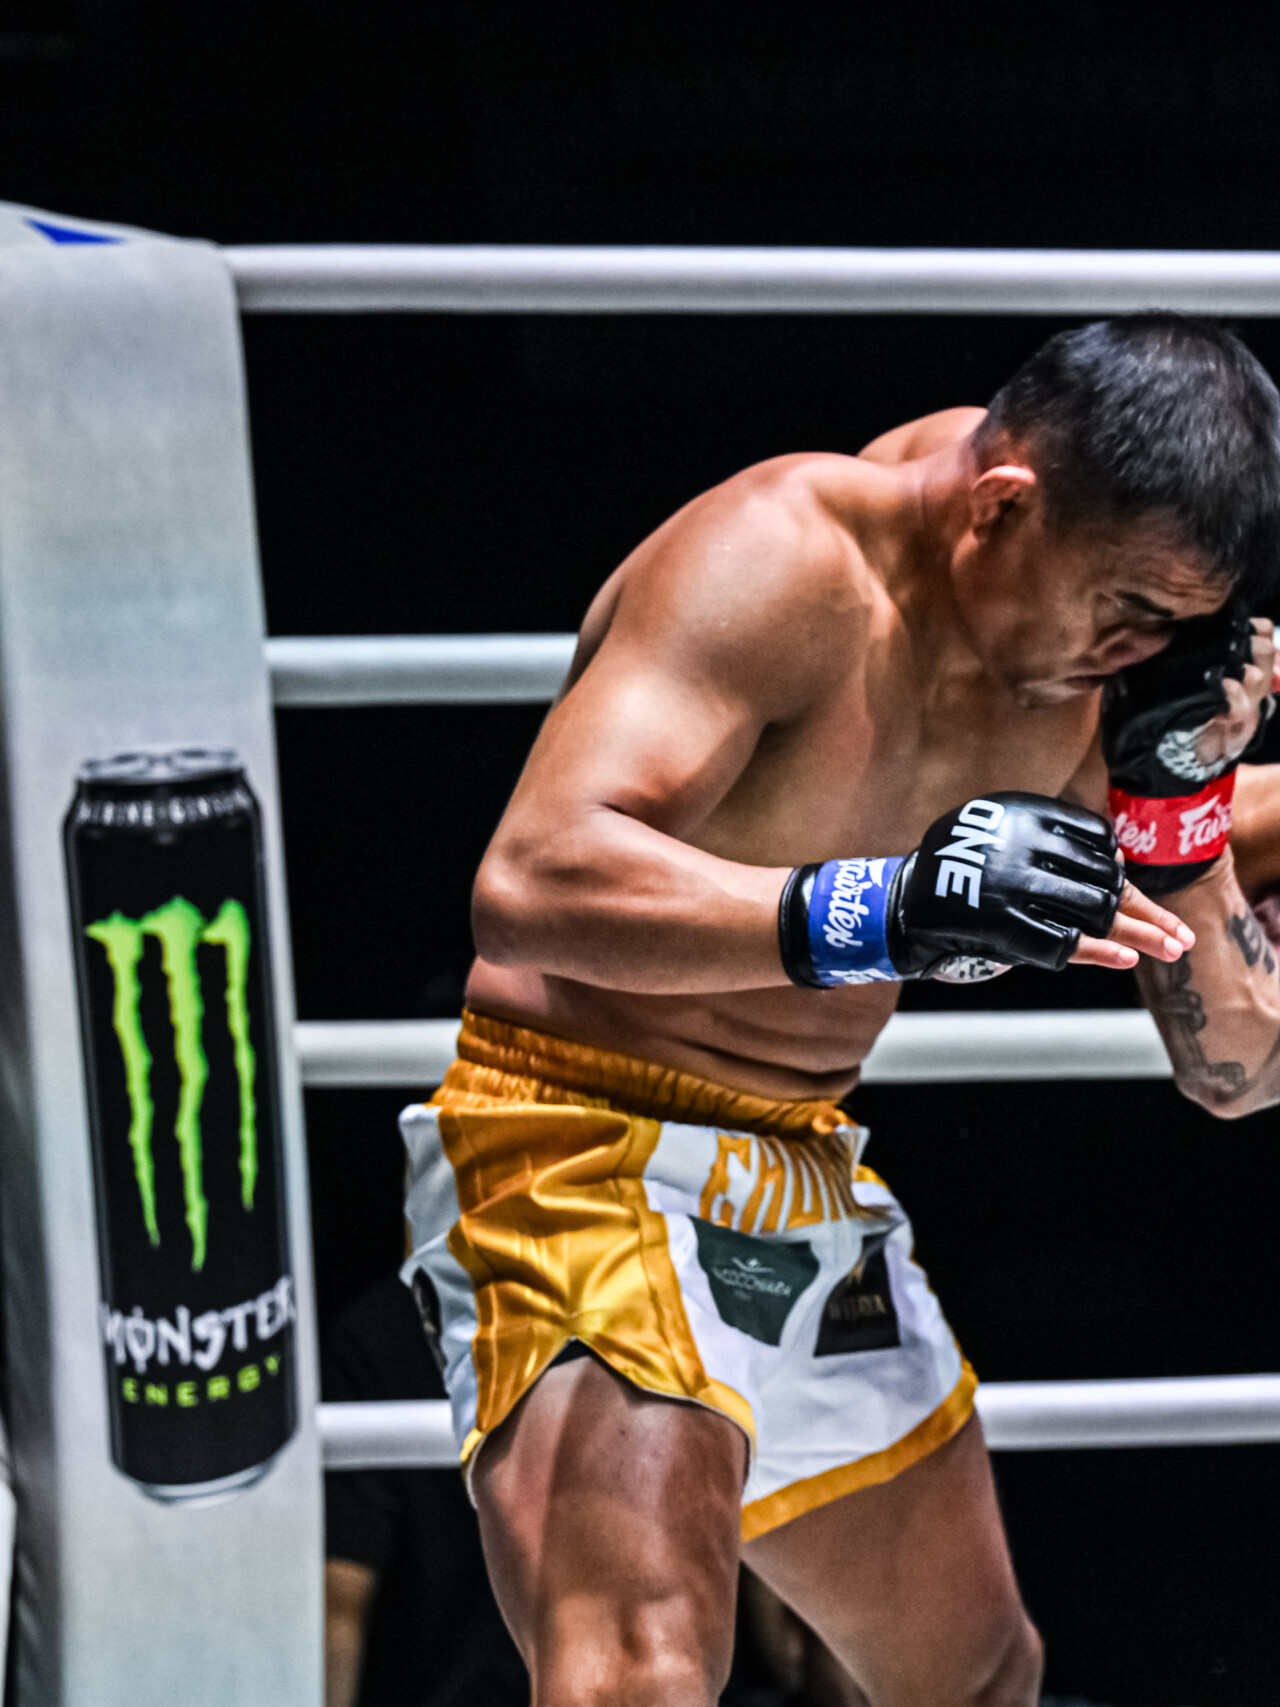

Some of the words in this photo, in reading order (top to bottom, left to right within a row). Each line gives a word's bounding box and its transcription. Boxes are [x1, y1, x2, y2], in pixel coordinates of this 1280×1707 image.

[934, 800, 1006, 909] ONE
[100, 1276, 297, 1375] MONSTER
[122, 1354, 280, 1408] ENERGY
